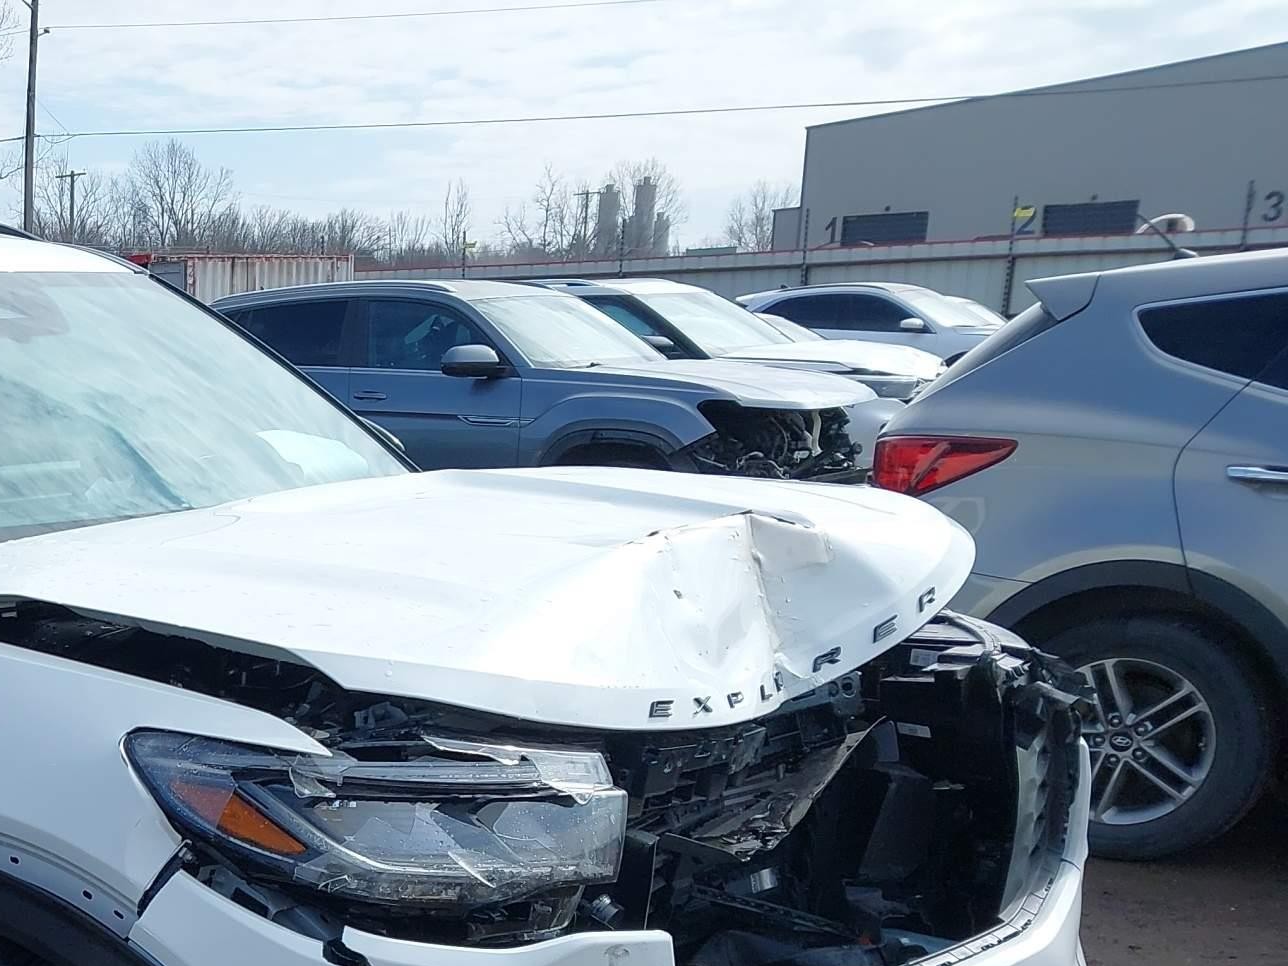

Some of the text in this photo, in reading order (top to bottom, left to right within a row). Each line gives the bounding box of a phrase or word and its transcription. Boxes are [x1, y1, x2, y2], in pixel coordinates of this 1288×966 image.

[1015, 205, 1036, 235] 2
[1262, 191, 1284, 222] 3
[825, 216, 838, 244] 1
